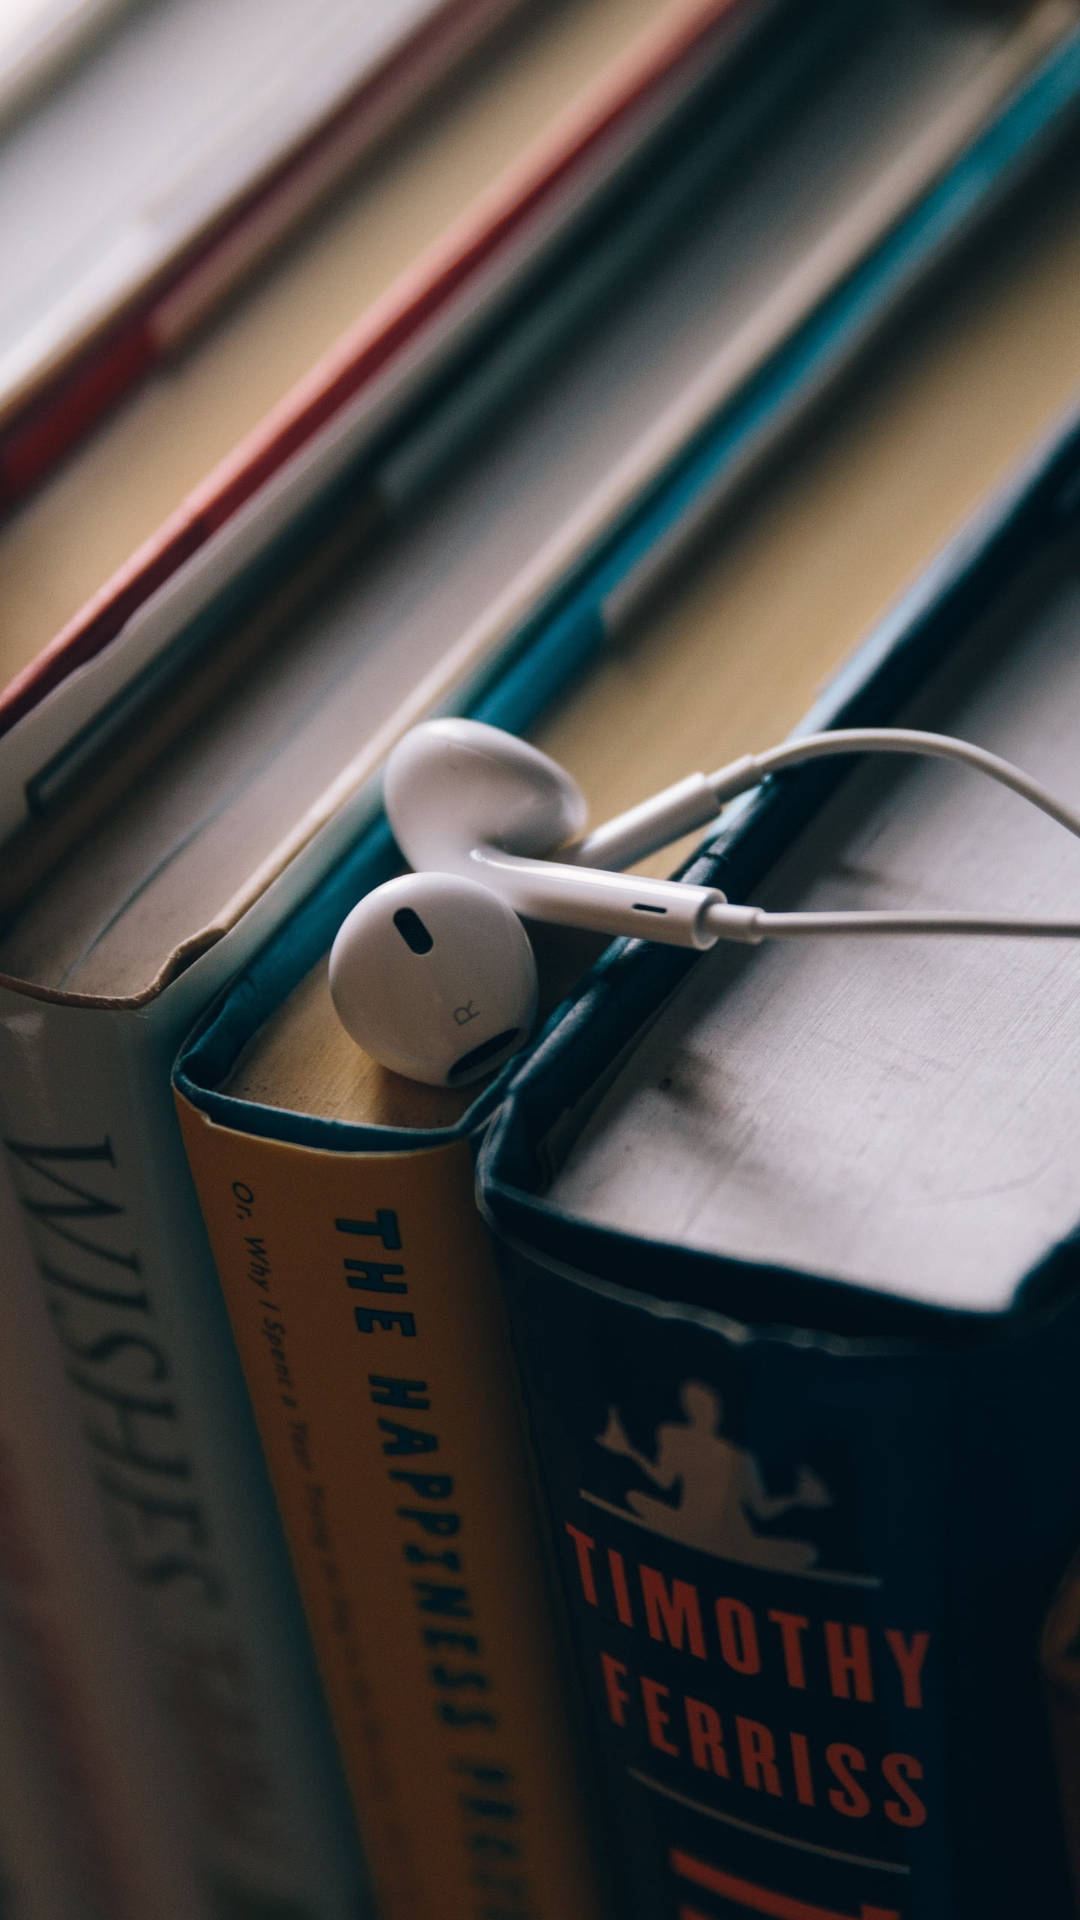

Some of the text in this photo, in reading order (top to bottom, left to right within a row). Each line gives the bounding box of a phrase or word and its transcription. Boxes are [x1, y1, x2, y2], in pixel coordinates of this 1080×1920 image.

[454, 1000, 480, 1025] R
[244, 1236, 272, 1292] Why
[259, 1300, 281, 1312] I
[335, 1209, 417, 1337] THE
[2, 1134, 226, 1609] WISHES
[262, 1317, 294, 1389] Spent
[368, 1373, 497, 1731] HAPPINESS
[565, 1521, 931, 1709] TIMOTHY
[600, 1650, 928, 1829] FERRISS
